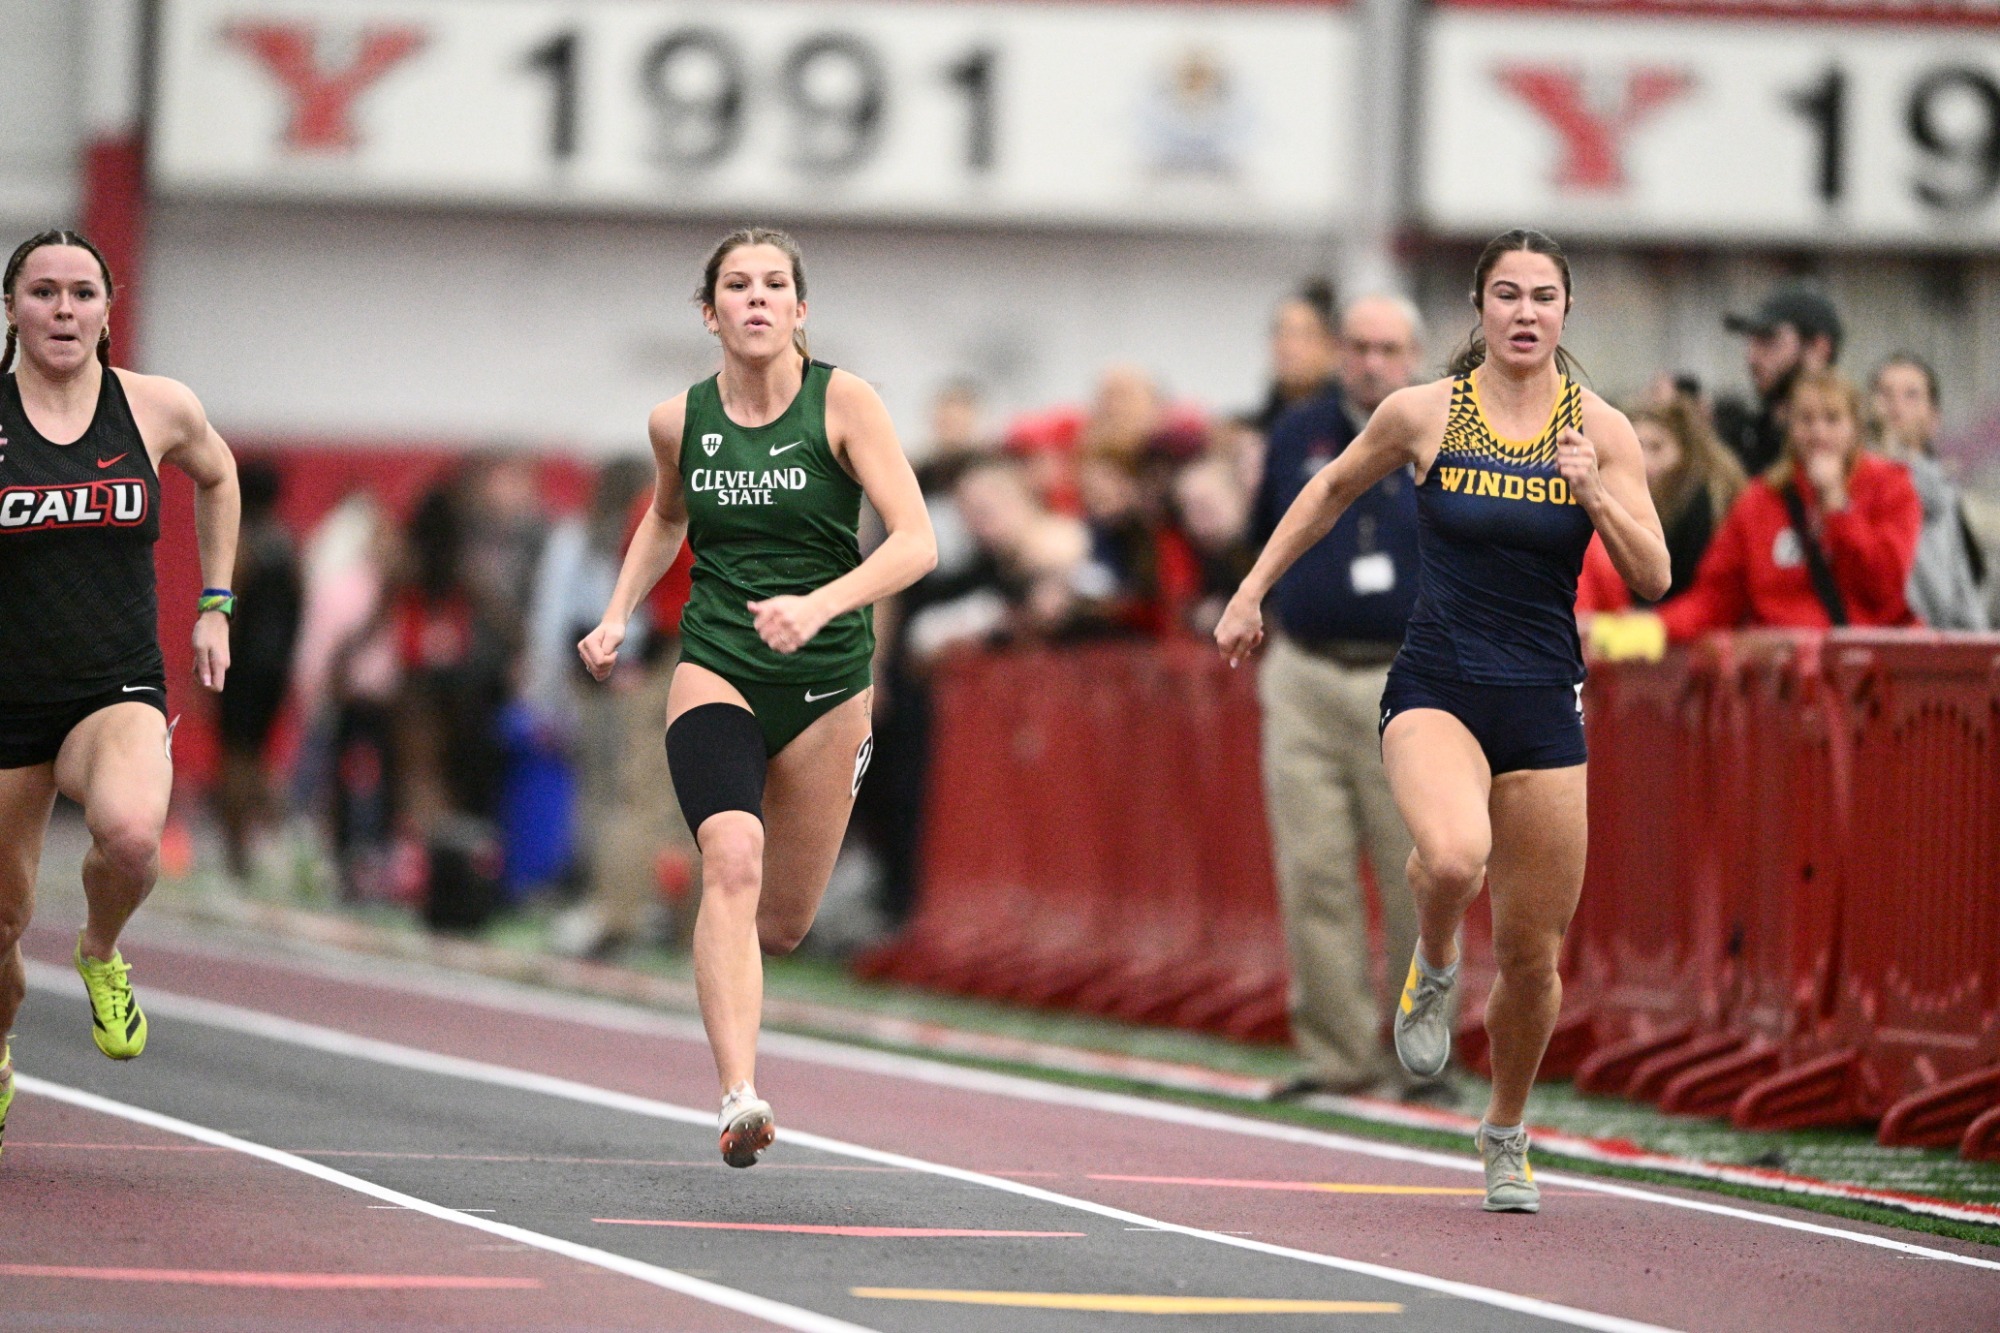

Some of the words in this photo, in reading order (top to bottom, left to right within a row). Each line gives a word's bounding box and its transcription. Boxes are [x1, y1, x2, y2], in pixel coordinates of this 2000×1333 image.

[222, 24, 428, 153] Y
[519, 28, 1002, 175] 1991
[1490, 60, 1698, 190] Y
[691, 467, 807, 492] CLEVELAND
[717, 489, 774, 506] STATE
